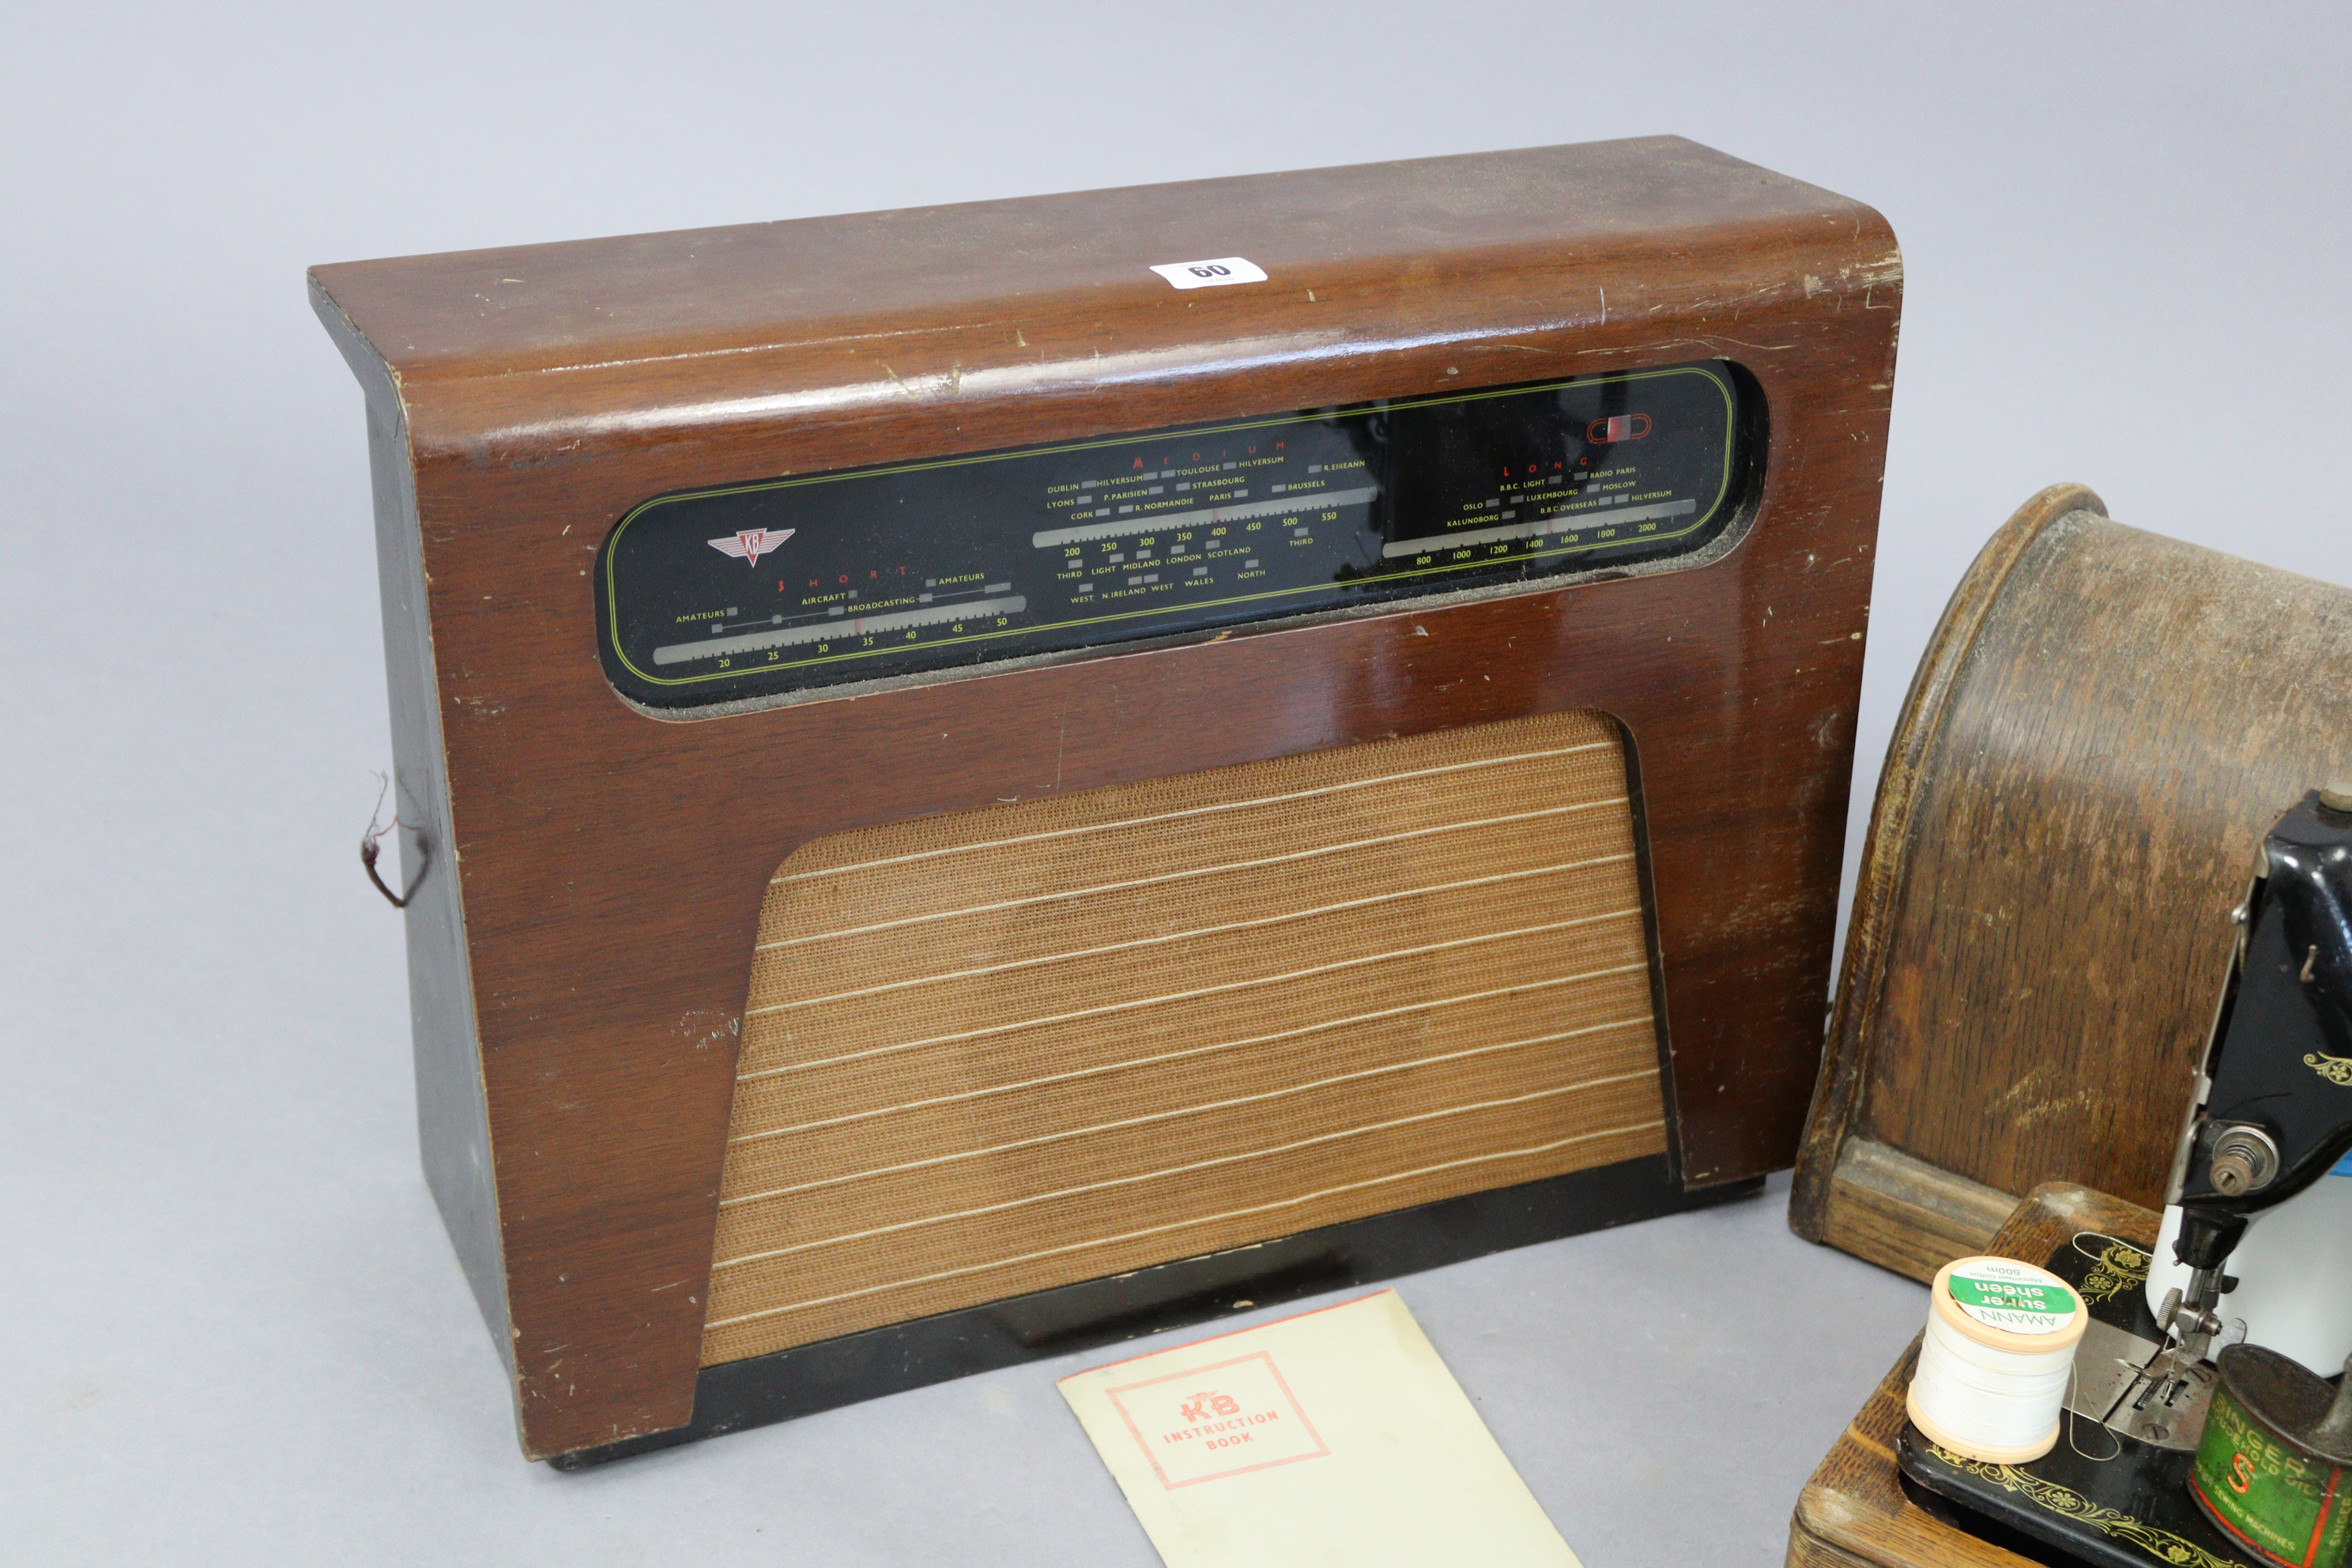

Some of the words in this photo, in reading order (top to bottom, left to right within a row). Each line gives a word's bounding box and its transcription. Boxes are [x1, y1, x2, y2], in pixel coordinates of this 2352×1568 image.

[1187, 265, 1231, 278] 60
[1133, 441, 1285, 469] MEDIUM
[1503, 457, 1588, 477] LONG
[1048, 483, 1079, 494] DUBLIN
[1097, 475, 1143, 487] HILVERSUM
[1177, 465, 1220, 476] TOULOUSE
[1239, 456, 1284, 467] HILVERSUM
[1523, 479, 1545, 488] LIGHT
[1590, 469, 1613, 478] RADIO
[1616, 466, 1636, 476] PARIS
[1046, 498, 1074, 509] LYONS
[1193, 476, 1245, 489] STRASBOURG
[1071, 511, 1093, 520] CORK
[1209, 492, 1231, 501] PARIS
[1287, 480, 1325, 491] BRUSSELS
[1447, 514, 1498, 527] KALUNDBORG
[1631, 490, 1672, 501] HILVERSUM
[1463, 502, 1483, 511] OSLO
[1526, 488, 1578, 502] LUXEMBOURG
[1602, 481, 1636, 491] MOSCOW
[745, 533, 759, 555] KB
[1065, 548, 1080, 556] 200
[1101, 543, 1117, 552] 250
[1139, 537, 1155, 546] 300
[1177, 532, 1192, 541] 350
[1211, 527, 1227, 536] 400
[1246, 522, 1261, 531] 450
[1283, 517, 1298, 526] 500
[1321, 511, 1336, 521] 550
[1416, 556, 1431, 564] 800
[1453, 550, 1471, 559] 1000
[1490, 545, 1507, 554] 1200
[1525, 538, 1543, 548] 1400
[1561, 533, 1578, 543] 1600
[1597, 529, 1615, 538] 1800
[1638, 522, 1656, 532] 2000
[1057, 571, 1082, 580] THIRD
[1091, 566, 1116, 575] LIGHT
[1123, 560, 1160, 571] MIDLAND
[1167, 553, 1201, 564] LONDON
[1208, 547, 1251, 559] SCOTLAND
[1289, 537, 1314, 547] THIRD
[778, 567, 906, 592] SHORT
[1071, 595, 1093, 604] WEST
[1152, 583, 1174, 592] WEST
[1185, 577, 1214, 587] WALES
[1238, 570, 1265, 580] NORTH
[676, 609, 725, 623] AMATEURS
[801, 593, 846, 605] AIRCRAFT
[938, 572, 985, 585] AMATEURS
[848, 596, 915, 612] BROADCASTING
[719, 658, 729, 668] 20
[767, 651, 779, 661] 25
[817, 643, 828, 653] 30
[863, 637, 873, 646] 35
[906, 630, 916, 640] 40
[952, 623, 963, 633] 45
[997, 616, 1007, 627] 50
[1986, 1266, 2021, 1276] 500m
[1997, 1275, 2042, 1283] Mercerised
[1974, 1282, 2045, 1298] sheen
[1980, 1310, 2056, 1326] AMANN
[1181, 1395, 1240, 1423] KB
[1163, 1410, 1279, 1444] INSTRUCTION
[1205, 1432, 1254, 1449] BOOK
[2214, 1392, 2307, 1478] SINGER
[2213, 1404, 2281, 1476] OUSEHOLD
[2285, 1474, 2316, 1496] OIL
[2226, 1451, 2256, 1495] S
[2214, 1485, 2243, 1518] SEWING
[2245, 1515, 2296, 1552] MACHINES
